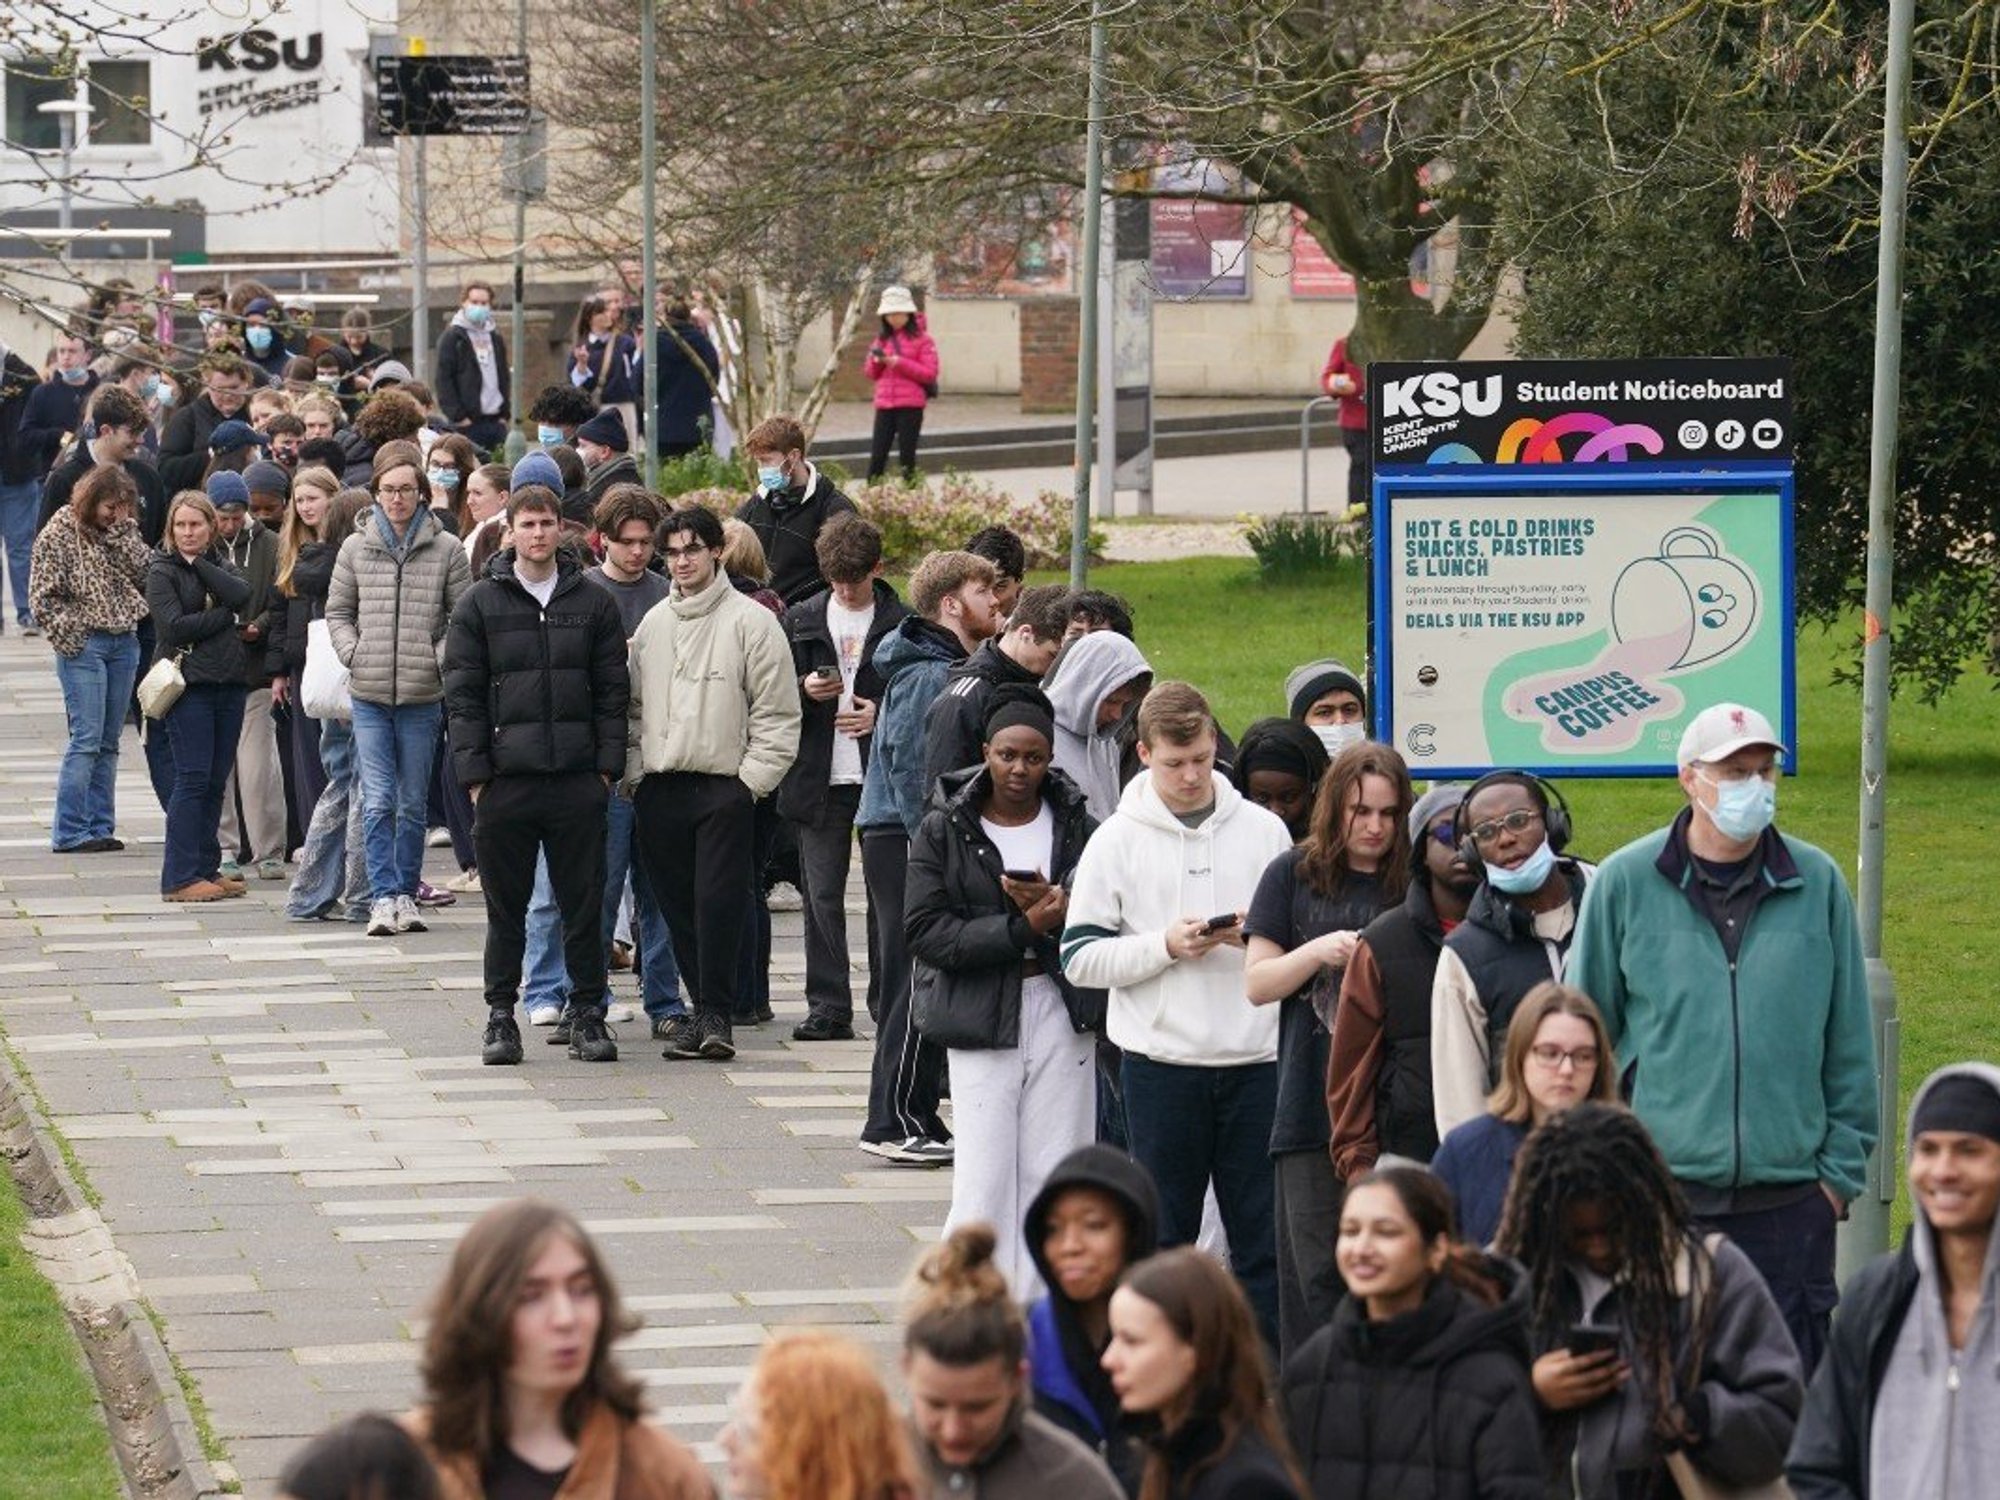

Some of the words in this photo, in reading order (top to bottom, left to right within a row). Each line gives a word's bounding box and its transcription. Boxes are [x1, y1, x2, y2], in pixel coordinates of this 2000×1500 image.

[198, 30, 323, 71] KSU
[198, 79, 256, 100] KENT
[248, 93, 320, 118] UNION
[1383, 372, 1503, 417] KSU
[1516, 380, 1618, 402] Student
[1624, 378, 1784, 400] Noticeboard
[1383, 418, 1424, 436] KENT
[1383, 436, 1428, 455] UNION
[1405, 520, 1442, 538] HOT
[1449, 520, 1462, 537] &
[1469, 519, 1518, 537] COLD
[1526, 518, 1595, 537] DRINKS
[1405, 540, 1485, 558] SNACKS,
[1492, 538, 1585, 556] PASTRIES
[1405, 559, 1419, 577] &
[1426, 559, 1489, 577] LUNCH
[1434, 585, 1475, 596] Monday
[1477, 584, 1518, 595] through
[1473, 596, 1486, 607] by
[1405, 613, 1454, 628] DEALS
[1459, 613, 1483, 628] VIA
[1488, 613, 1517, 627] THE
[1522, 613, 1551, 627] KSU
[1556, 612, 1586, 627] APP
[1535, 671, 1634, 715] CAMPUS
[1557, 685, 1661, 738] COFFEE
